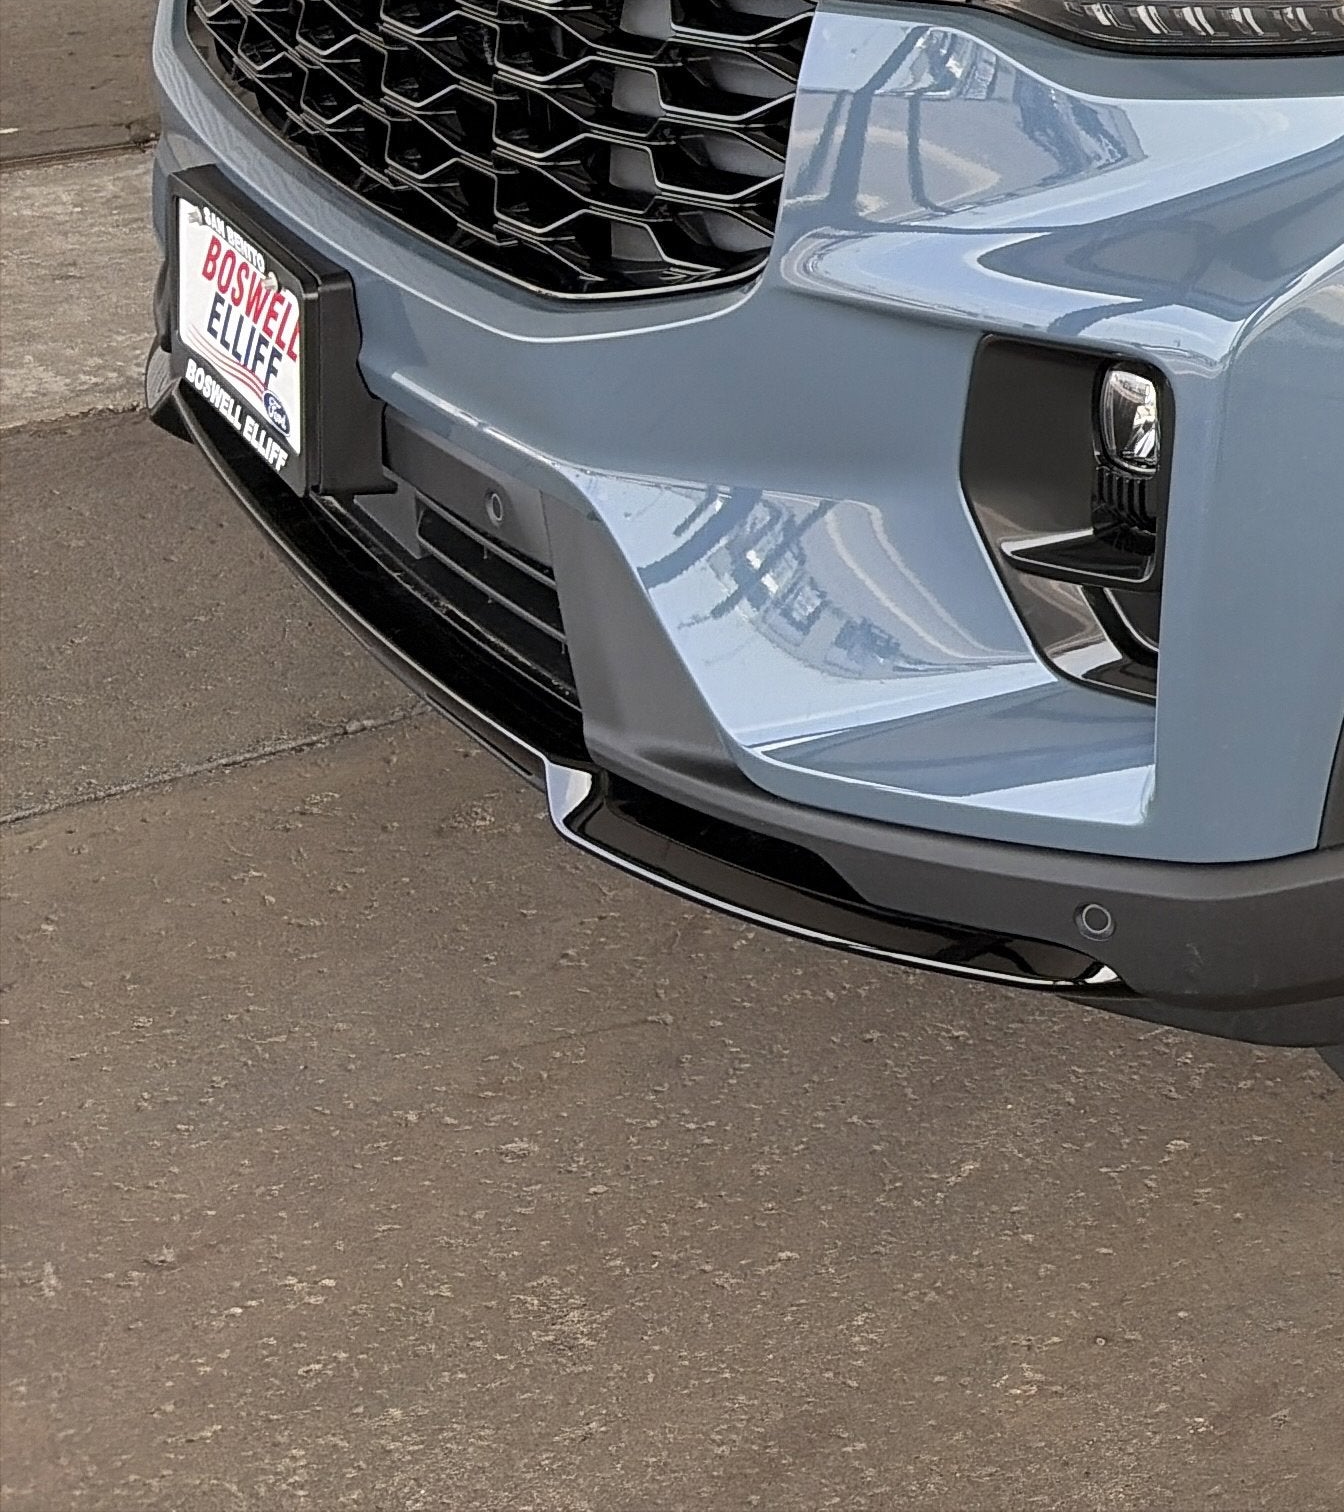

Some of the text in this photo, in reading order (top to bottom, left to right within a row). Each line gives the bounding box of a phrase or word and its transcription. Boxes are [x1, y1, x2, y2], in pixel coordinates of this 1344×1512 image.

[203, 206, 266, 274] SAN BENITO
[207, 291, 282, 390] ELLIFF
[185, 358, 289, 473] BOSWELL ELLIFF
[267, 395, 288, 431] Ford
